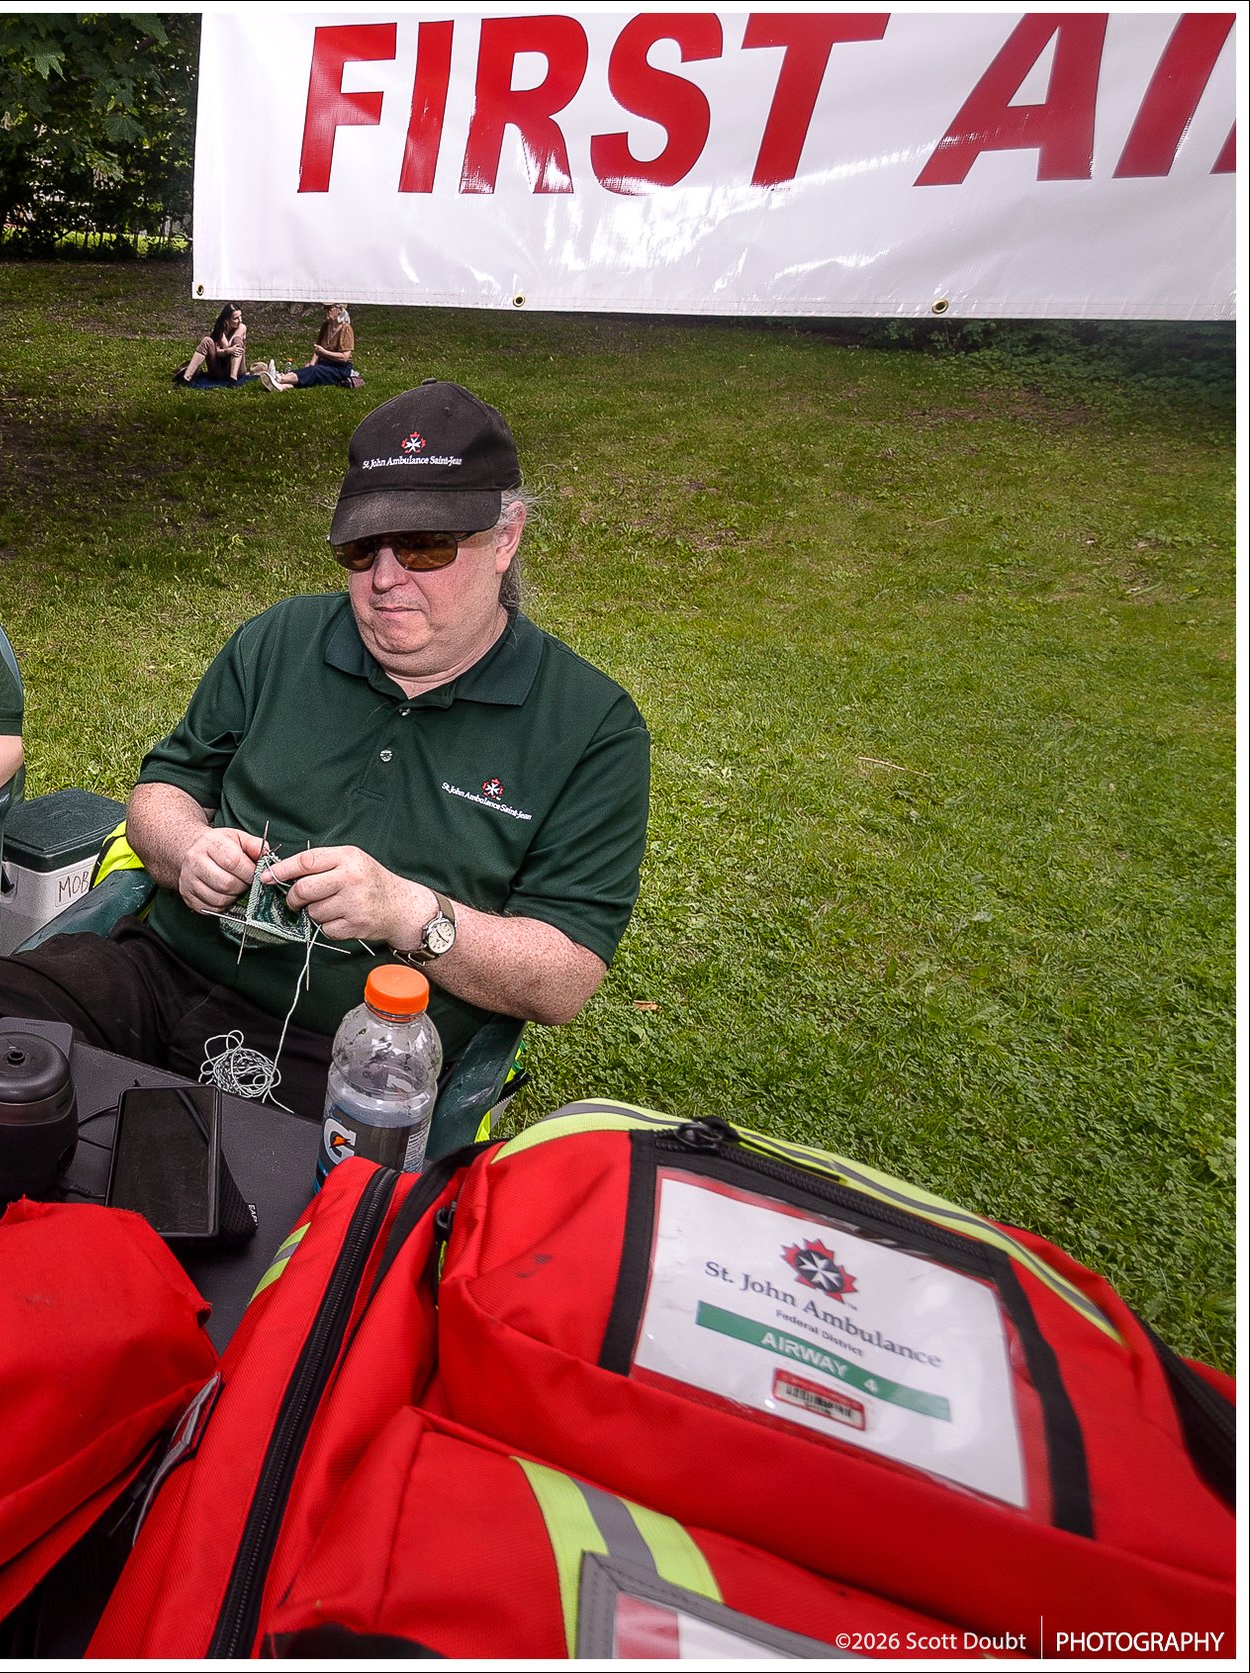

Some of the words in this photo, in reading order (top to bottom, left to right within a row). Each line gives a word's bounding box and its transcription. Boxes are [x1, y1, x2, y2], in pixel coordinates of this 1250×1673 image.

[297, 13, 891, 196] FIRST
[912, 13, 1236, 187] AI
[386, 455, 429, 467] Ambulance
[464, 791, 501, 810] Ambulance
[500, 803, 532, 821] Saint-Jean
[58, 870, 90, 903] MOB
[323, 1117, 357, 1165] G
[704, 1260, 735, 1285] St.
[739, 1273, 797, 1308] John
[802, 1298, 944, 1369] Ambulance
[775, 1308, 819, 1335] Federal
[821, 1329, 866, 1358] District
[760, 1330, 850, 1378] AIRWAY
[862, 1377, 879, 1395] 4
